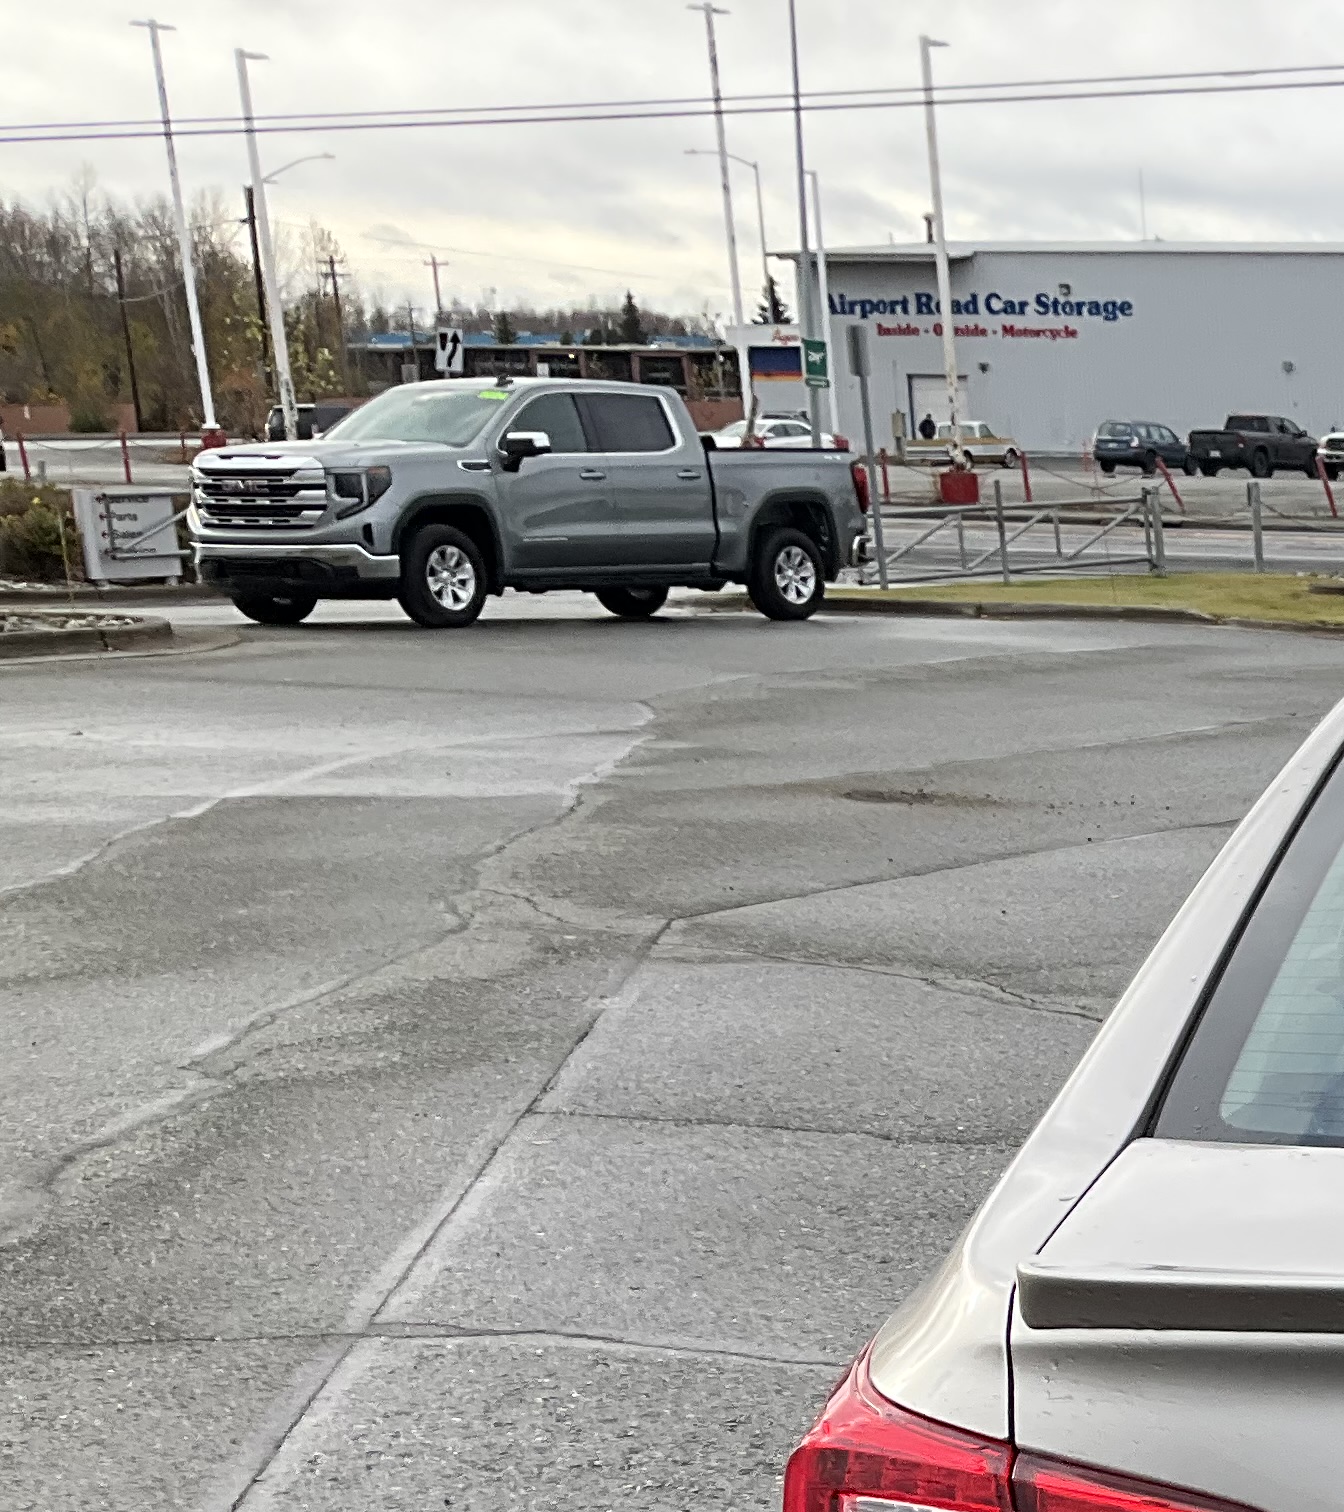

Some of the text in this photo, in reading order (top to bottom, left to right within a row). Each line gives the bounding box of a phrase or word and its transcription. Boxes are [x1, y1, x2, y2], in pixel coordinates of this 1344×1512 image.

[984, 292, 1029, 316] Car
[1033, 292, 1134, 321] Storage
[1001, 324, 1078, 341] Motorcycle
